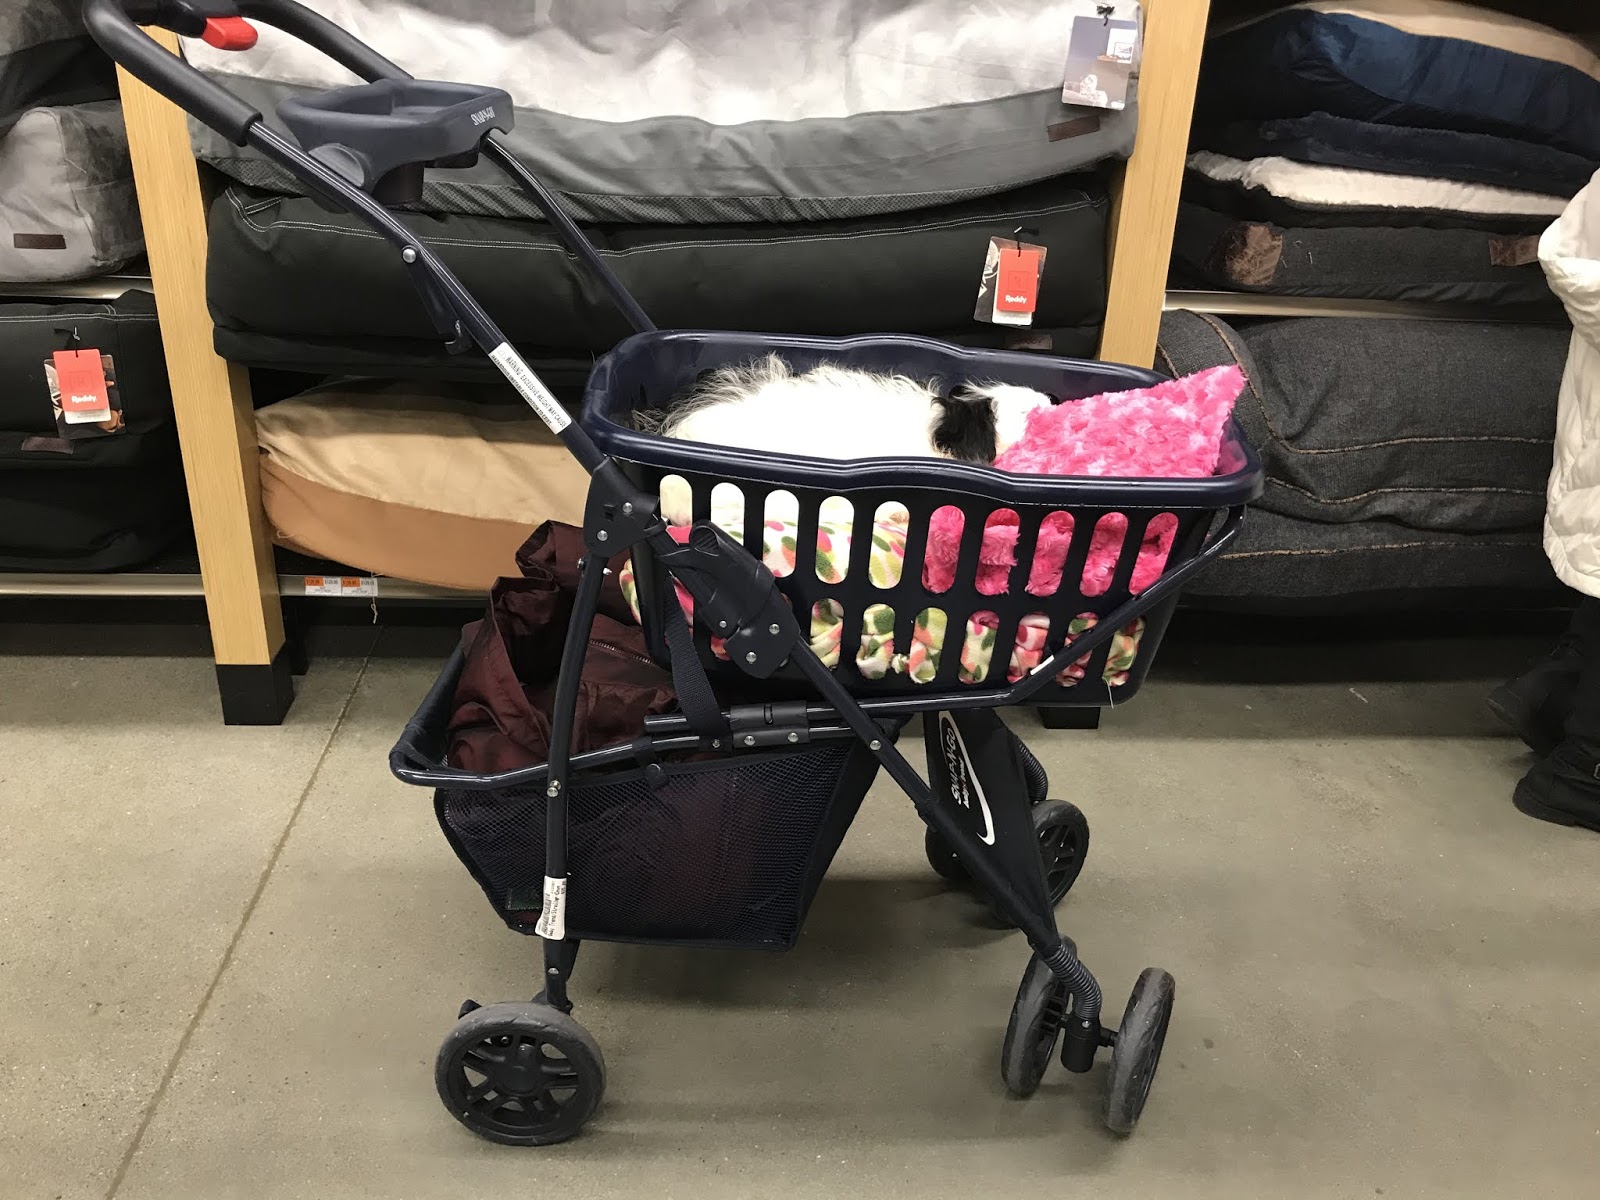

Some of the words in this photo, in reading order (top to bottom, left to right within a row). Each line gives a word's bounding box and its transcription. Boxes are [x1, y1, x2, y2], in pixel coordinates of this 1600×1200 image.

[1005, 294, 1027, 304] Reddy
[71, 394, 97, 404] Reddy
[946, 727, 962, 805] SNAP-N-GO
